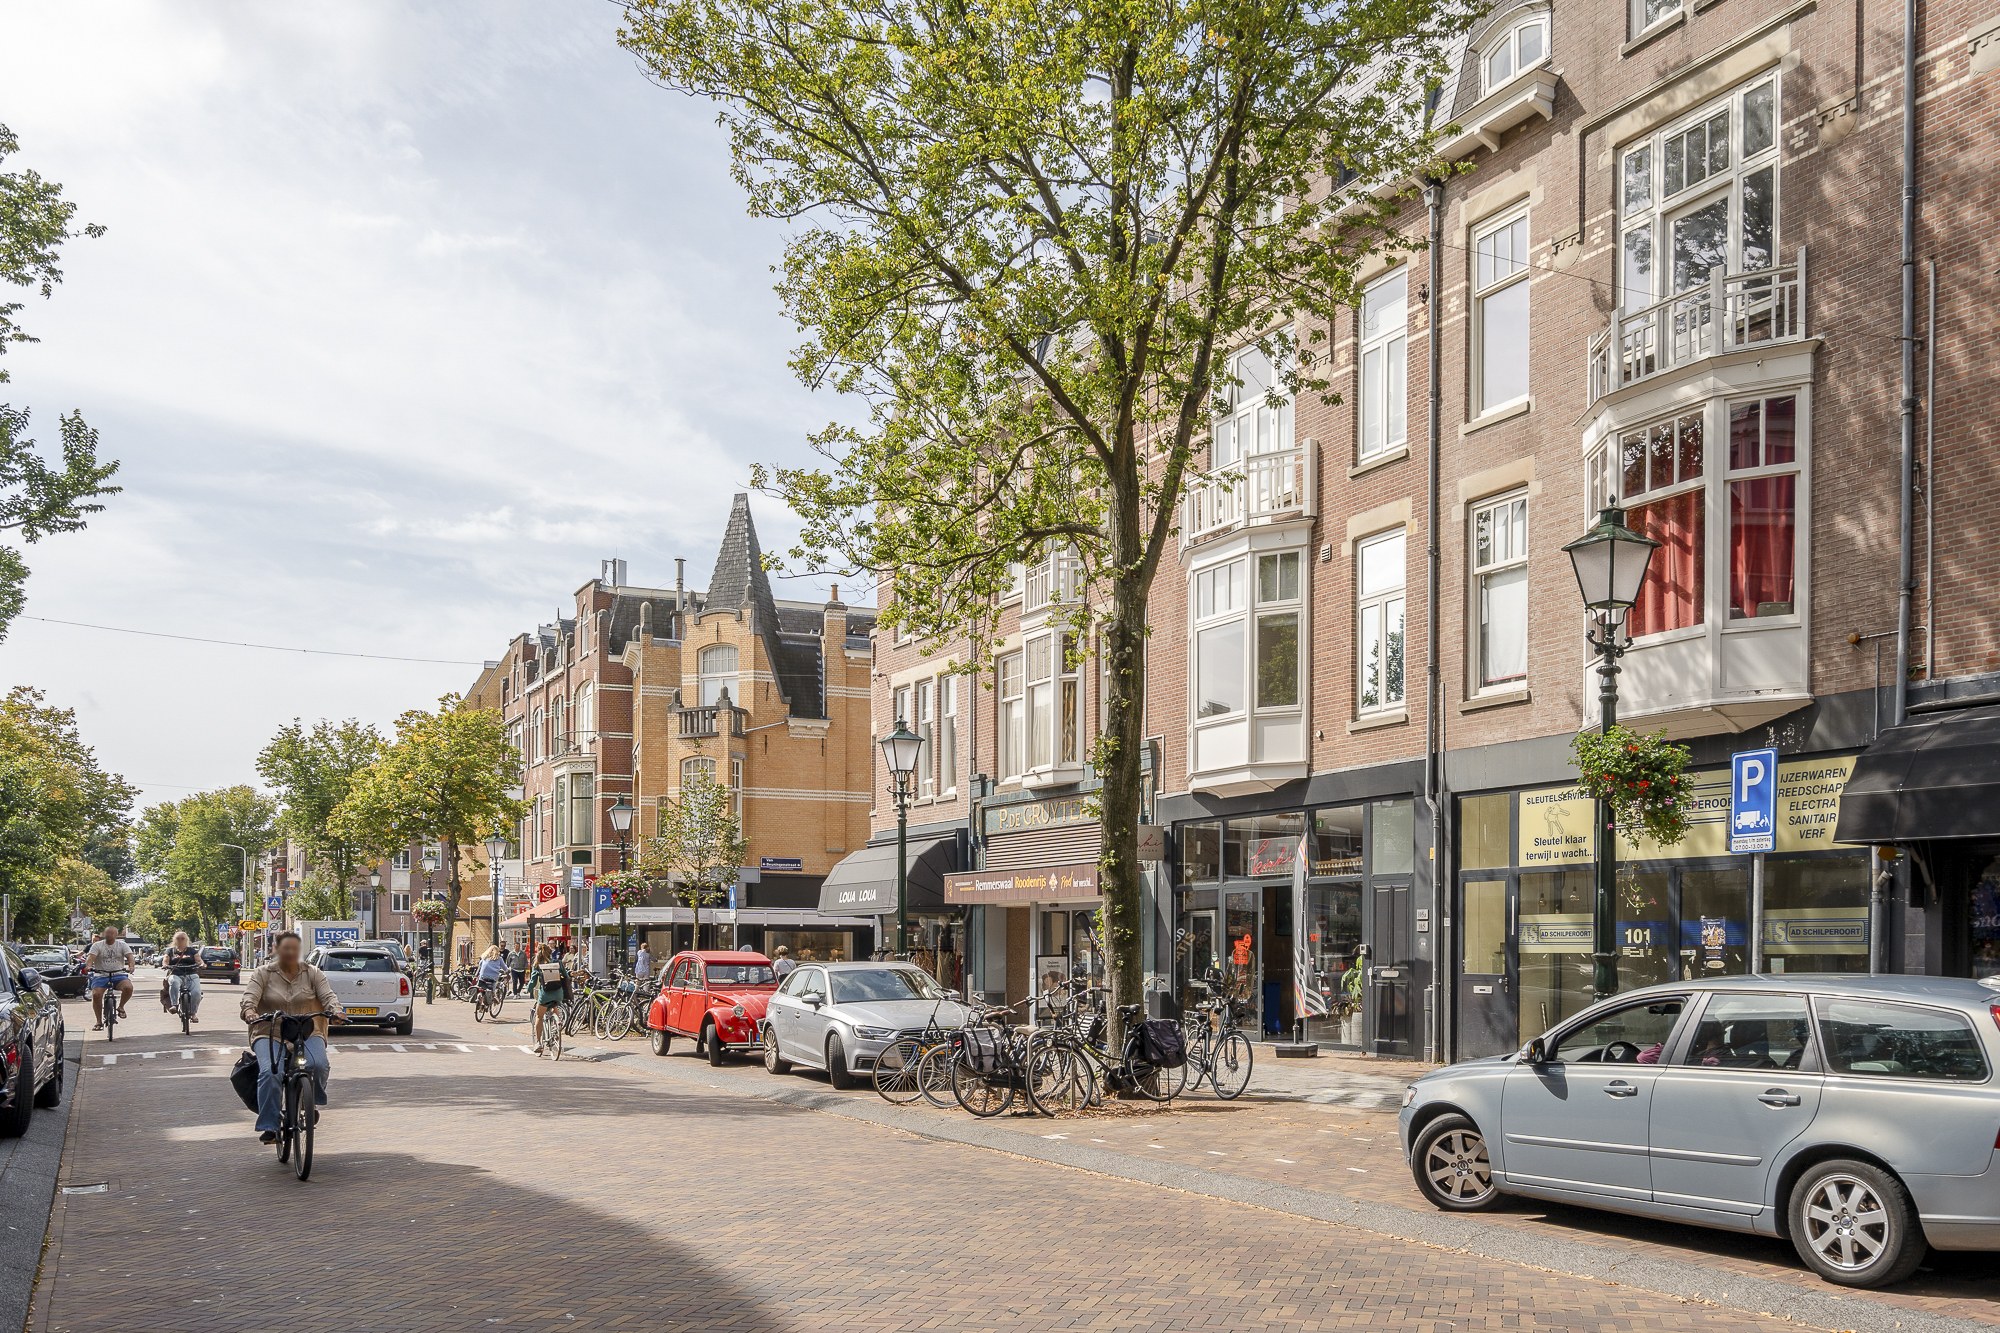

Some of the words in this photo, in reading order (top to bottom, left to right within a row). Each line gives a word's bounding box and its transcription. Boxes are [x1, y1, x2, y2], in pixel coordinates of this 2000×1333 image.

[1741, 759, 1765, 803] P
[1780, 767, 1847, 783] IJZERWAREN
[1526, 791, 1590, 805] SLEUTELSERVICE
[1789, 798, 1837, 812] ELECTRA
[1023, 797, 1090, 826] GRUYTER
[1788, 813, 1837, 826] SANITAIR
[1799, 828, 1826, 839] VERF
[1534, 836, 1563, 847] Sleutel
[1565, 835, 1587, 845] klaar
[1526, 850, 1552, 861] terwijl
[1554, 851, 1559, 859] u
[600, 895, 607, 905] P
[317, 930, 357, 939] LETSCH
[1309, 933, 1320, 942] 107
[1625, 928, 1650, 944] 101
[1791, 928, 1801, 936] AD
[1803, 927, 1861, 936] SCHILPEROORT
